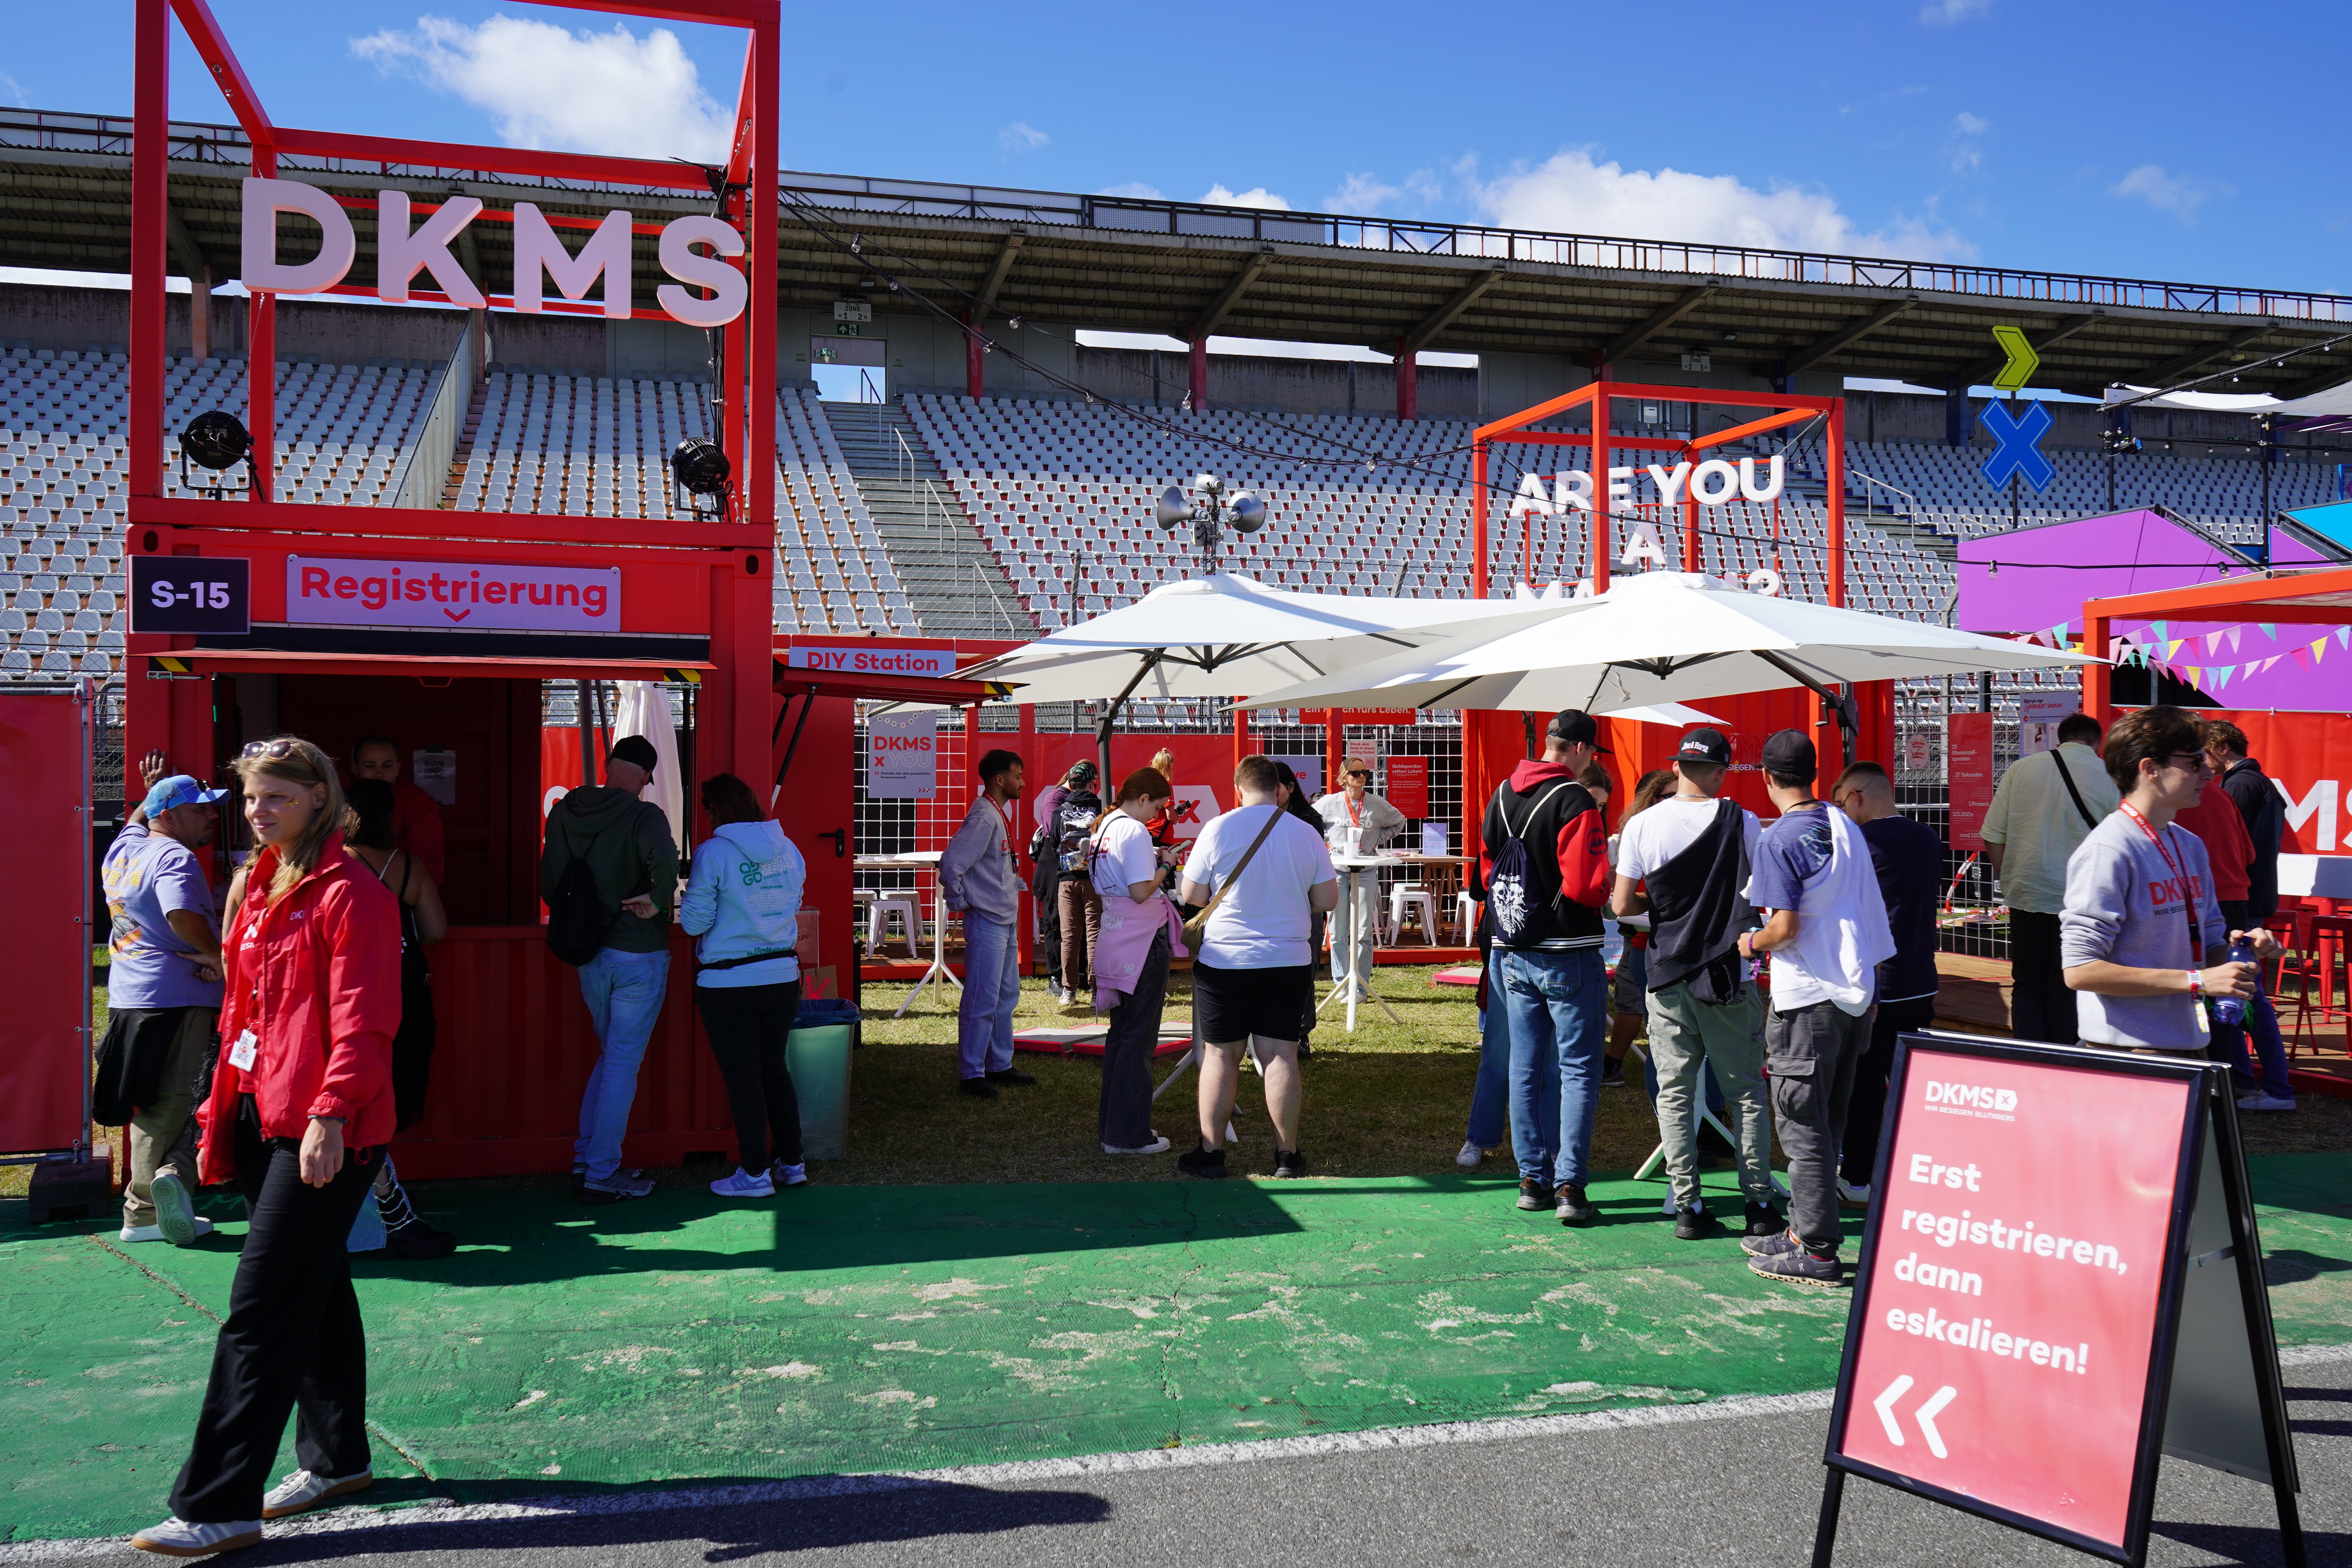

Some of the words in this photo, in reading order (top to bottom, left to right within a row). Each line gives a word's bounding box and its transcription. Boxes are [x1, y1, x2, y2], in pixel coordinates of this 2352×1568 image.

[241, 177, 748, 327] DKMS
[1510, 466, 1634, 517] ARE
[1647, 456, 1784, 507] YOU
[1621, 522, 1667, 564] A
[151, 581, 230, 609] S-15
[301, 566, 608, 617] Registrierung
[808, 652, 847, 669] DIY
[854, 653, 938, 671] Station
[874, 737, 931, 751] DKMS
[888, 752, 931, 767] YOU
[290, 910, 305, 920] DK
[1926, 1081, 1994, 1109] DKMS
[1939, 1106, 1973, 1116] BESIEGEN
[1975, 1111, 2015, 1122] BLUTKREBS
[586, 1183, 613, 1192] SALOMON
[1909, 1153, 1982, 1192] Erst
[1901, 1209, 2127, 1275] registrieren,
[1894, 1252, 1982, 1296] dann
[1886, 1307, 2089, 1374] eskalieren!
